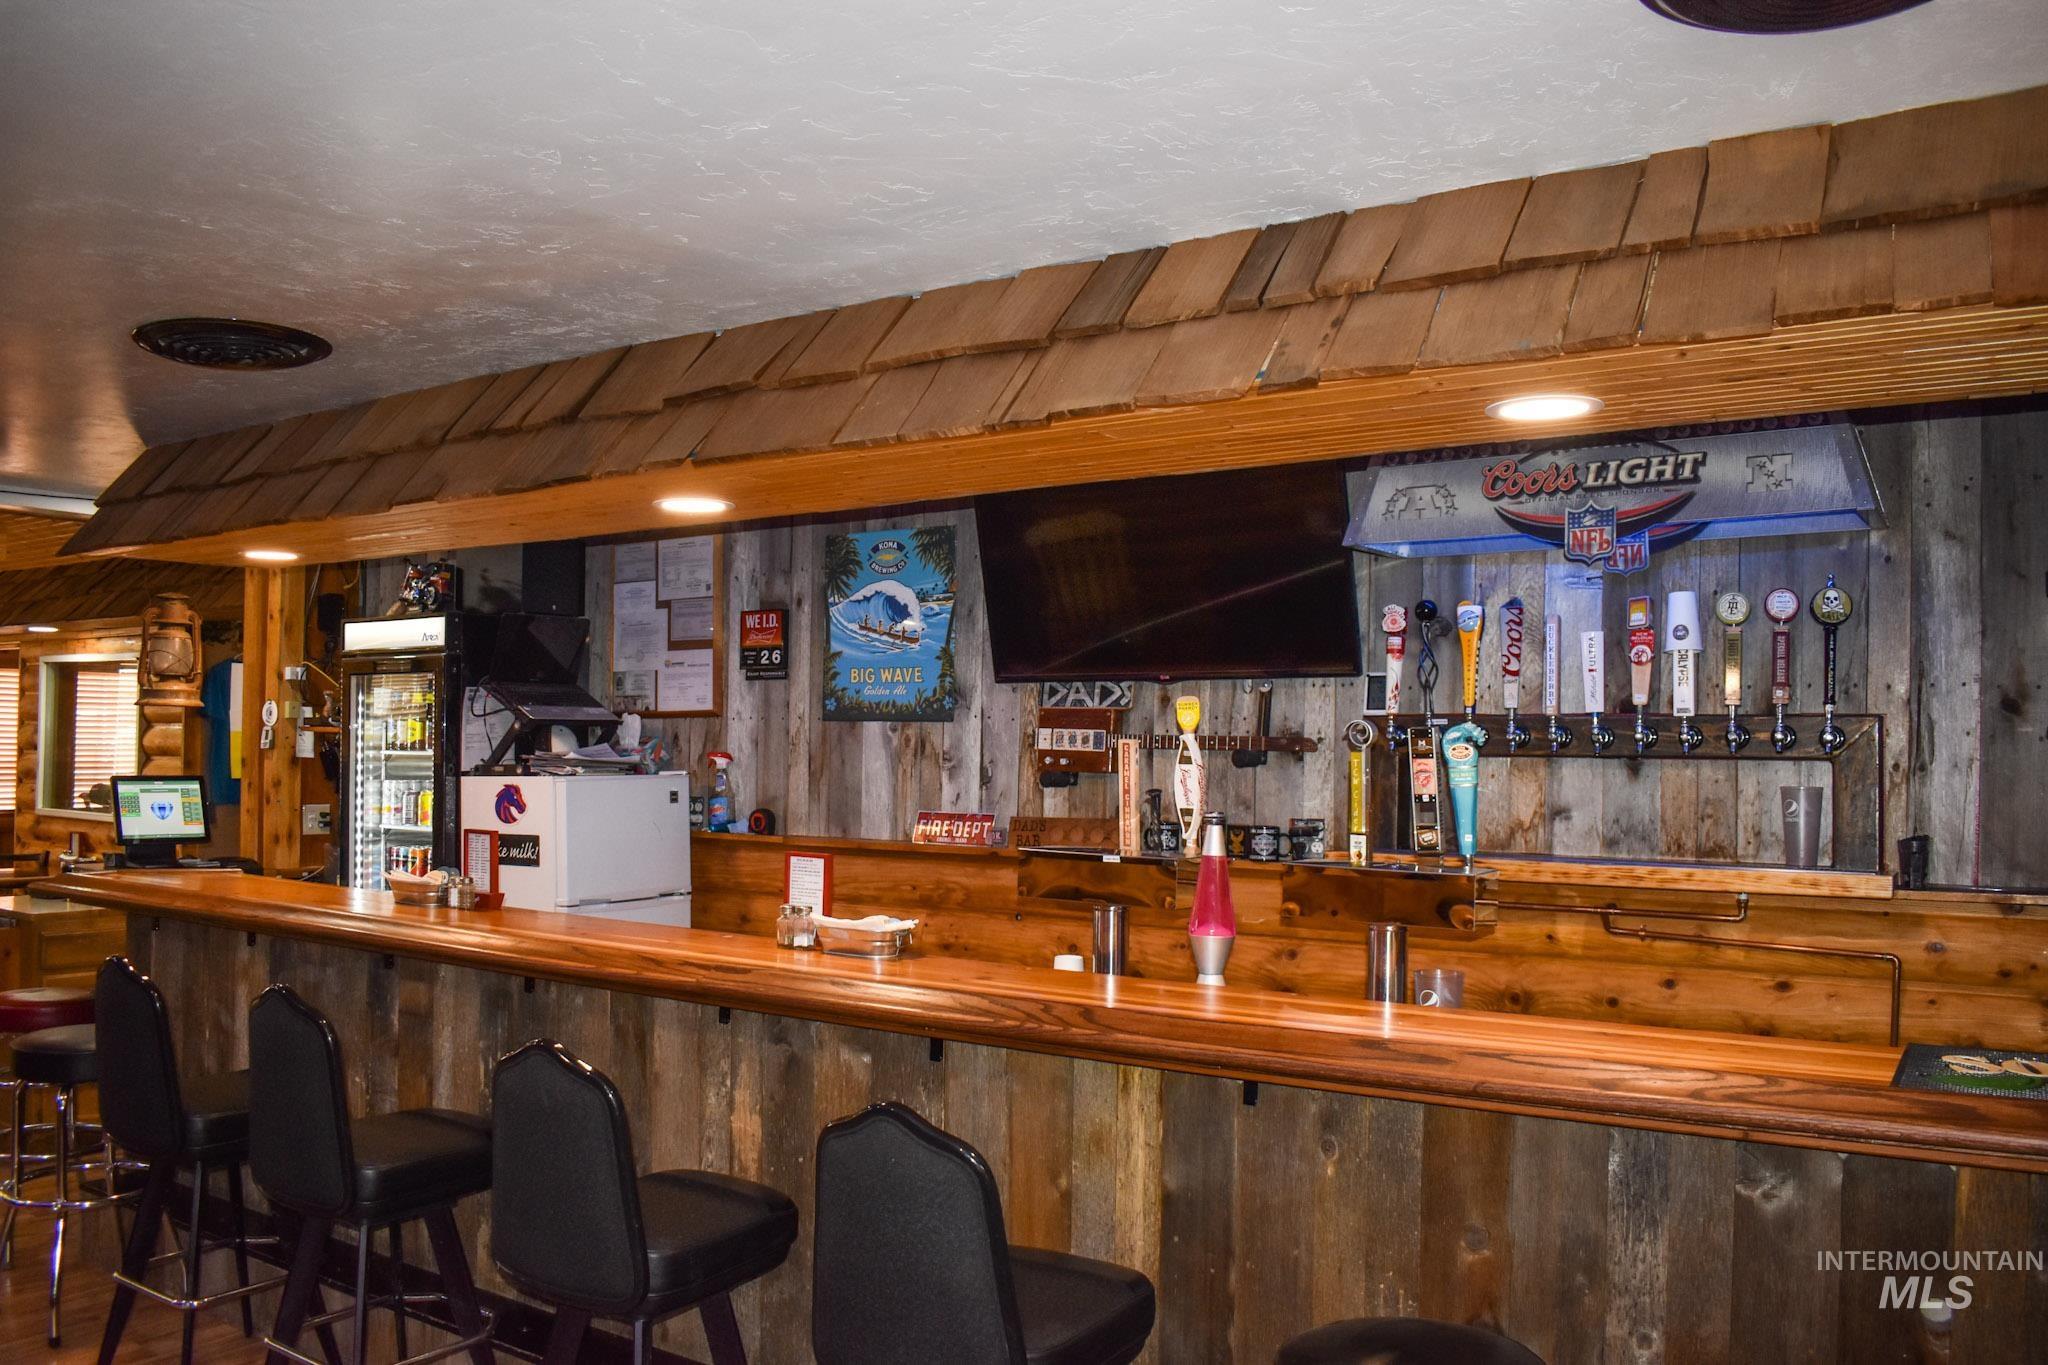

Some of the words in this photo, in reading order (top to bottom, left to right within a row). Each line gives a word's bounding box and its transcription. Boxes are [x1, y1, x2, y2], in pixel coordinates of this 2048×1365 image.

[1482, 460, 1578, 498] Coors
[1584, 452, 1704, 488] LIGHT
[879, 541, 898, 550] KONA
[1570, 527, 1611, 556] NFL
[871, 562, 898, 574] BREWING
[745, 614, 761, 628] WE
[763, 613, 779, 628] I.D.
[1502, 607, 1523, 678] Coors
[760, 650, 781, 664] 26
[1588, 636, 1596, 667] ULTRA
[850, 668, 876, 683] BIG
[880, 667, 924, 683] WAVE
[864, 685, 890, 695] Golden
[893, 684, 908, 695] Ale
[1041, 680, 1134, 708] DADS
[917, 819, 951, 837] FIRE
[952, 820, 992, 839] DEPT
[1016, 834, 1041, 847] BAR
[509, 841, 539, 860] milk!
